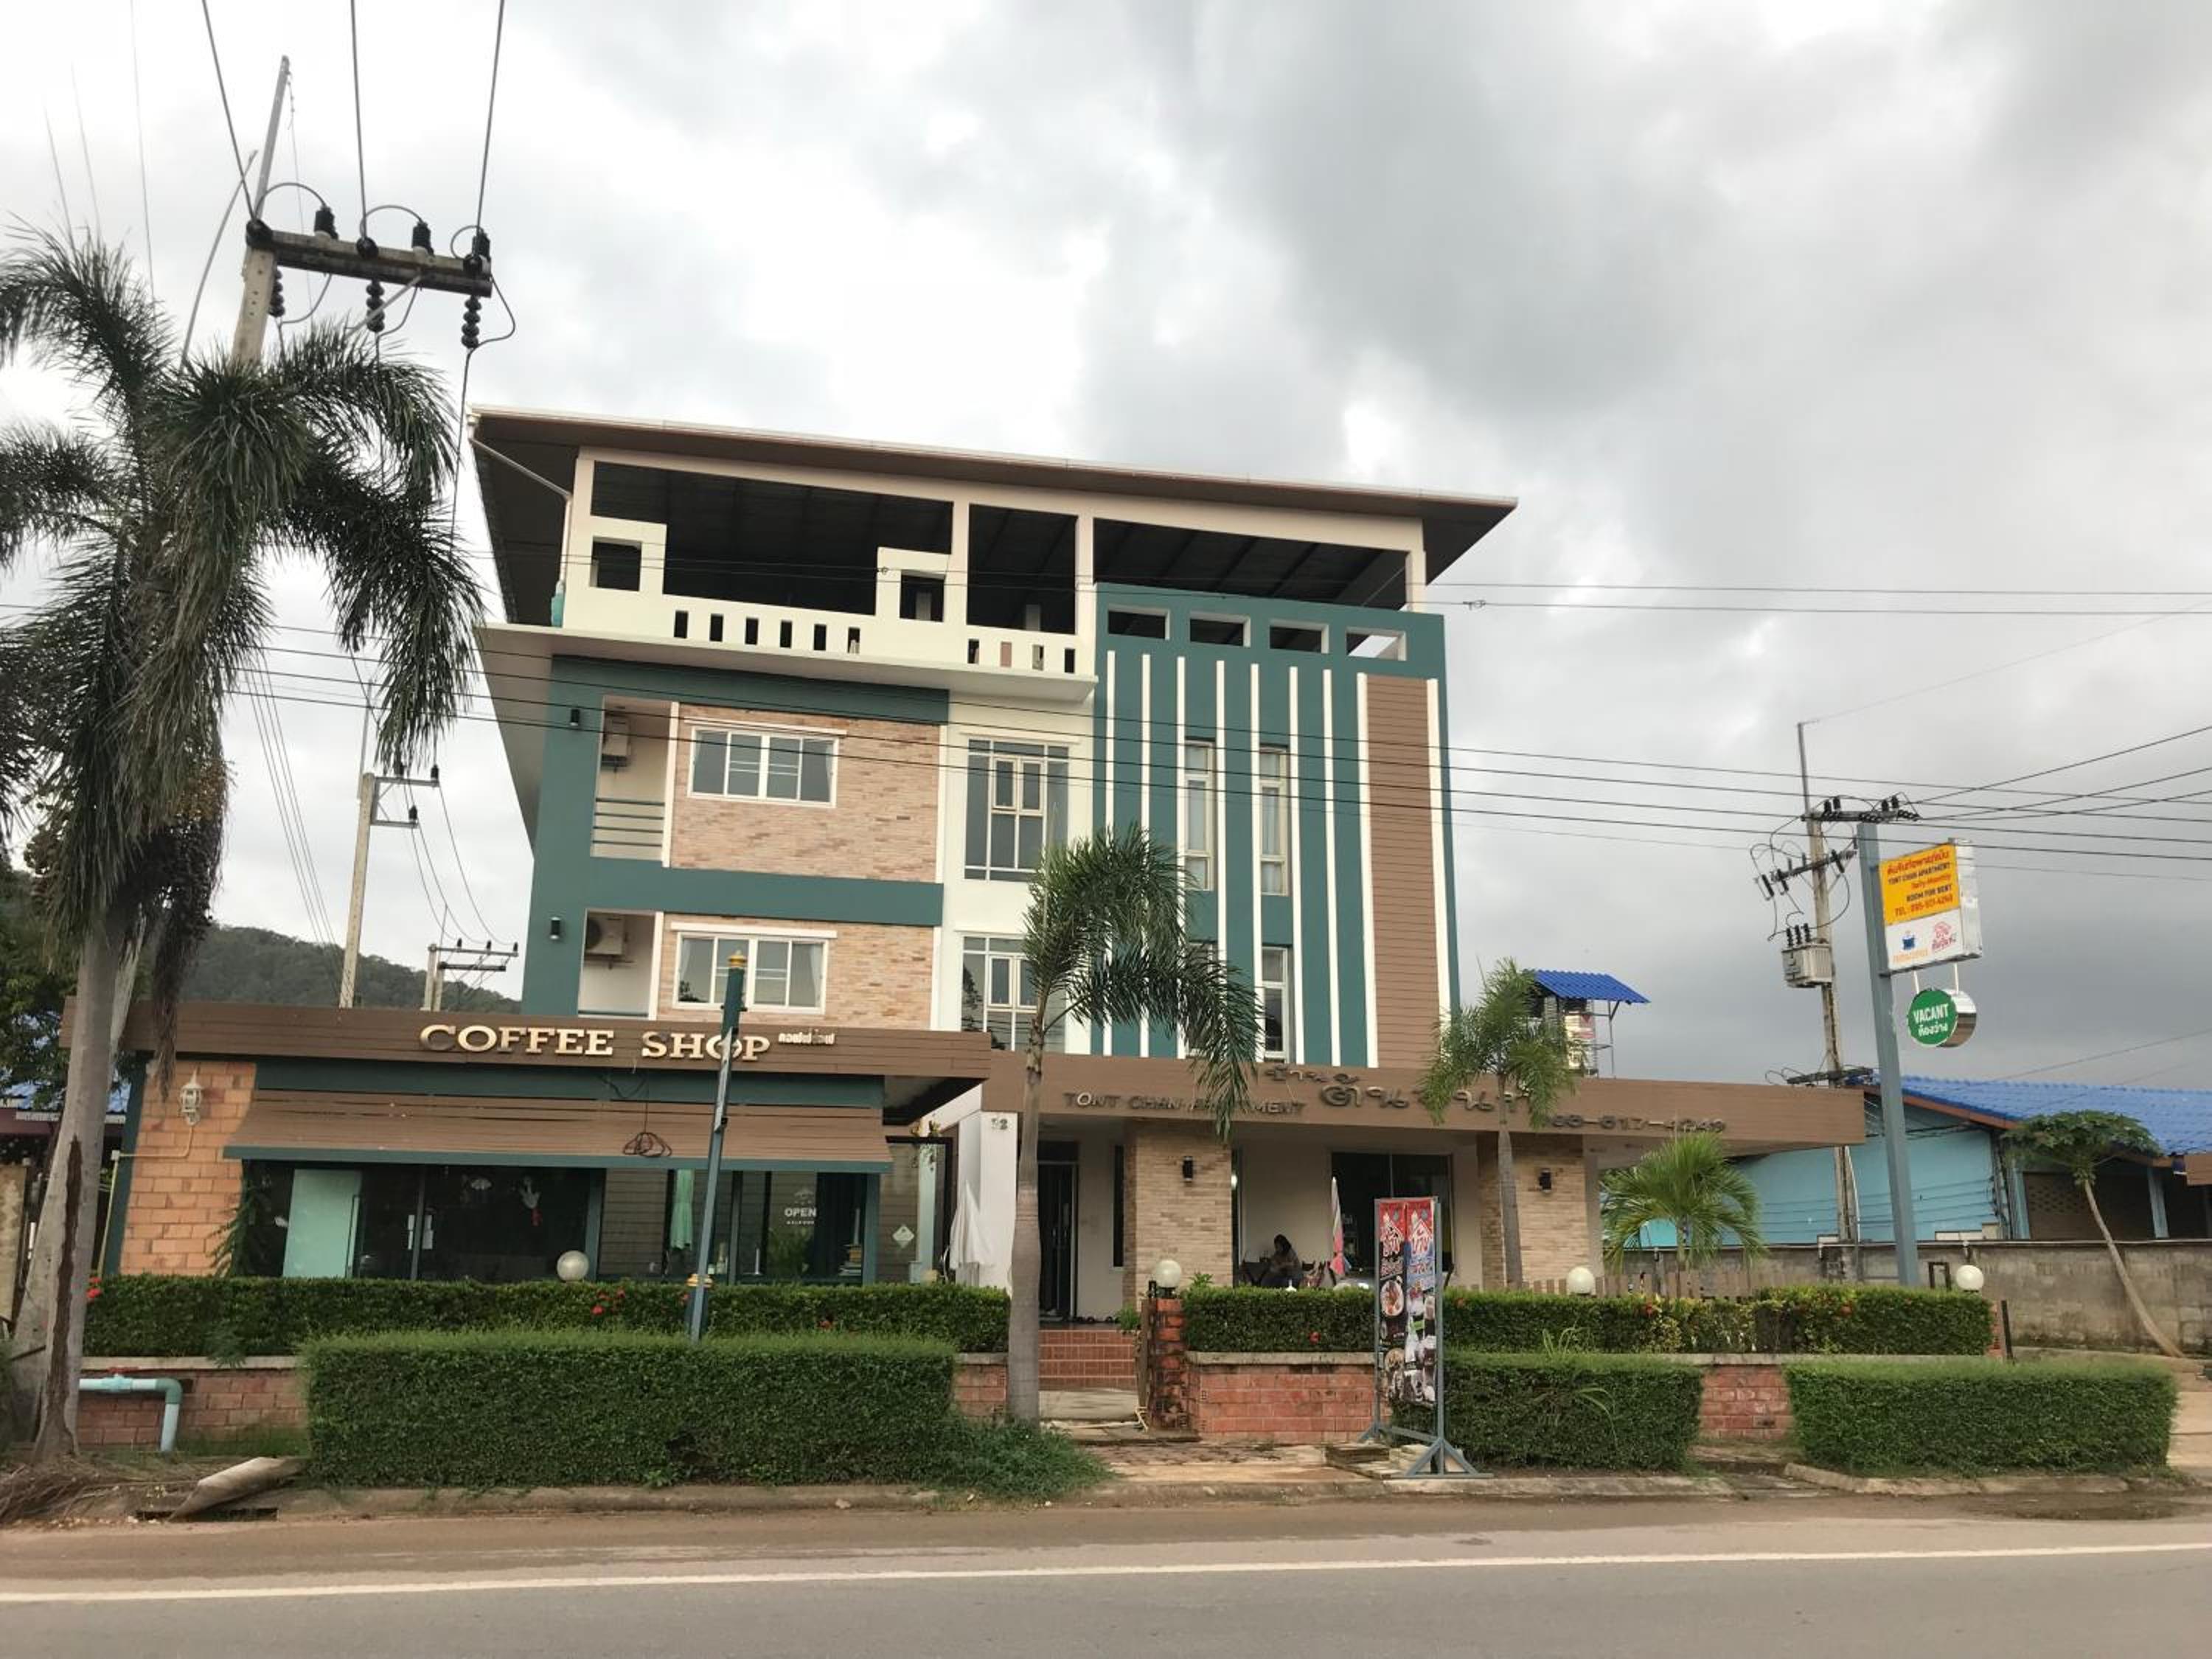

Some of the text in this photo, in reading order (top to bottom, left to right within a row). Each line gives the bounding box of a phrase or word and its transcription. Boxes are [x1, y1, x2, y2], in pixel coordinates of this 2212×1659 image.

[1913, 1003, 1949, 1024] VACANT
[420, 1023, 771, 1061] COFFEE SHOP
[784, 1207, 817, 1217] OPEN
